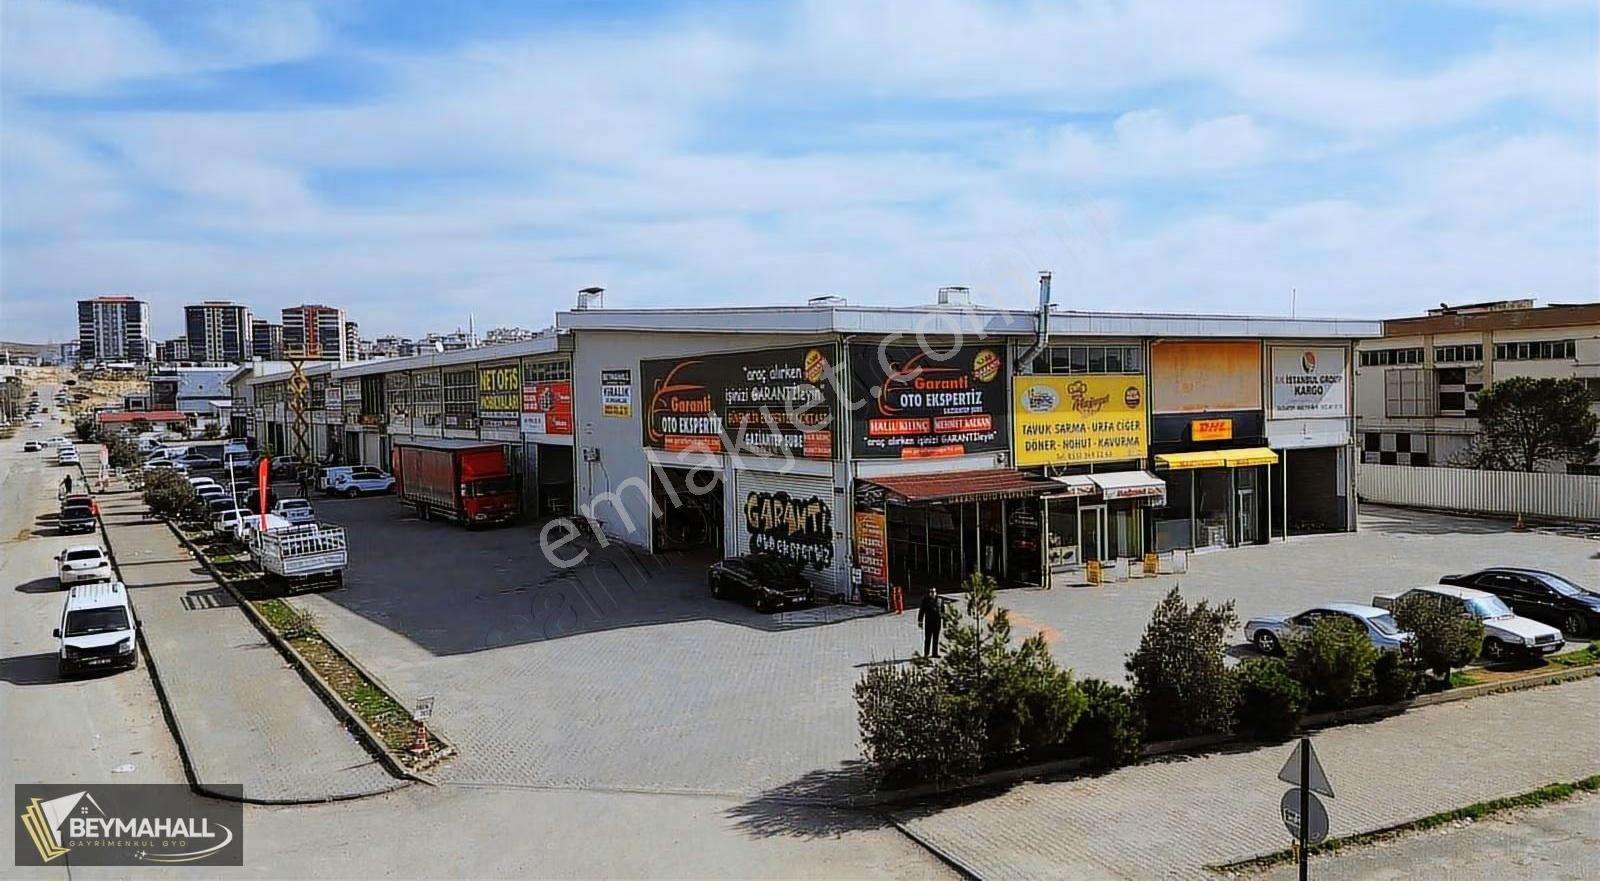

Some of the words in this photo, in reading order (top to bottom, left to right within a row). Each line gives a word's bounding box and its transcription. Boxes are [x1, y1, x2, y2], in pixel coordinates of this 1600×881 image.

[914, 375, 968, 390] Garanti
[1294, 385, 1324, 395] KARGO
[671, 393, 711, 412] Garanti
[900, 393, 922, 407] OTO
[926, 388, 983, 407] EKSPERTİZ
[661, 416, 678, 433] OTO
[679, 413, 723, 434] EKSPERTİZ
[1022, 423, 1052, 435] TAVUK
[1055, 422, 1086, 434] SARMA
[1092, 421, 1115, 433] URFA
[1198, 421, 1226, 432] DHL
[1024, 439, 1057, 452] DÖNER
[1062, 438, 1092, 450] NOHUT
[1098, 436, 1140, 448] KAVURMA
[747, 494, 827, 536] GARANTİ
